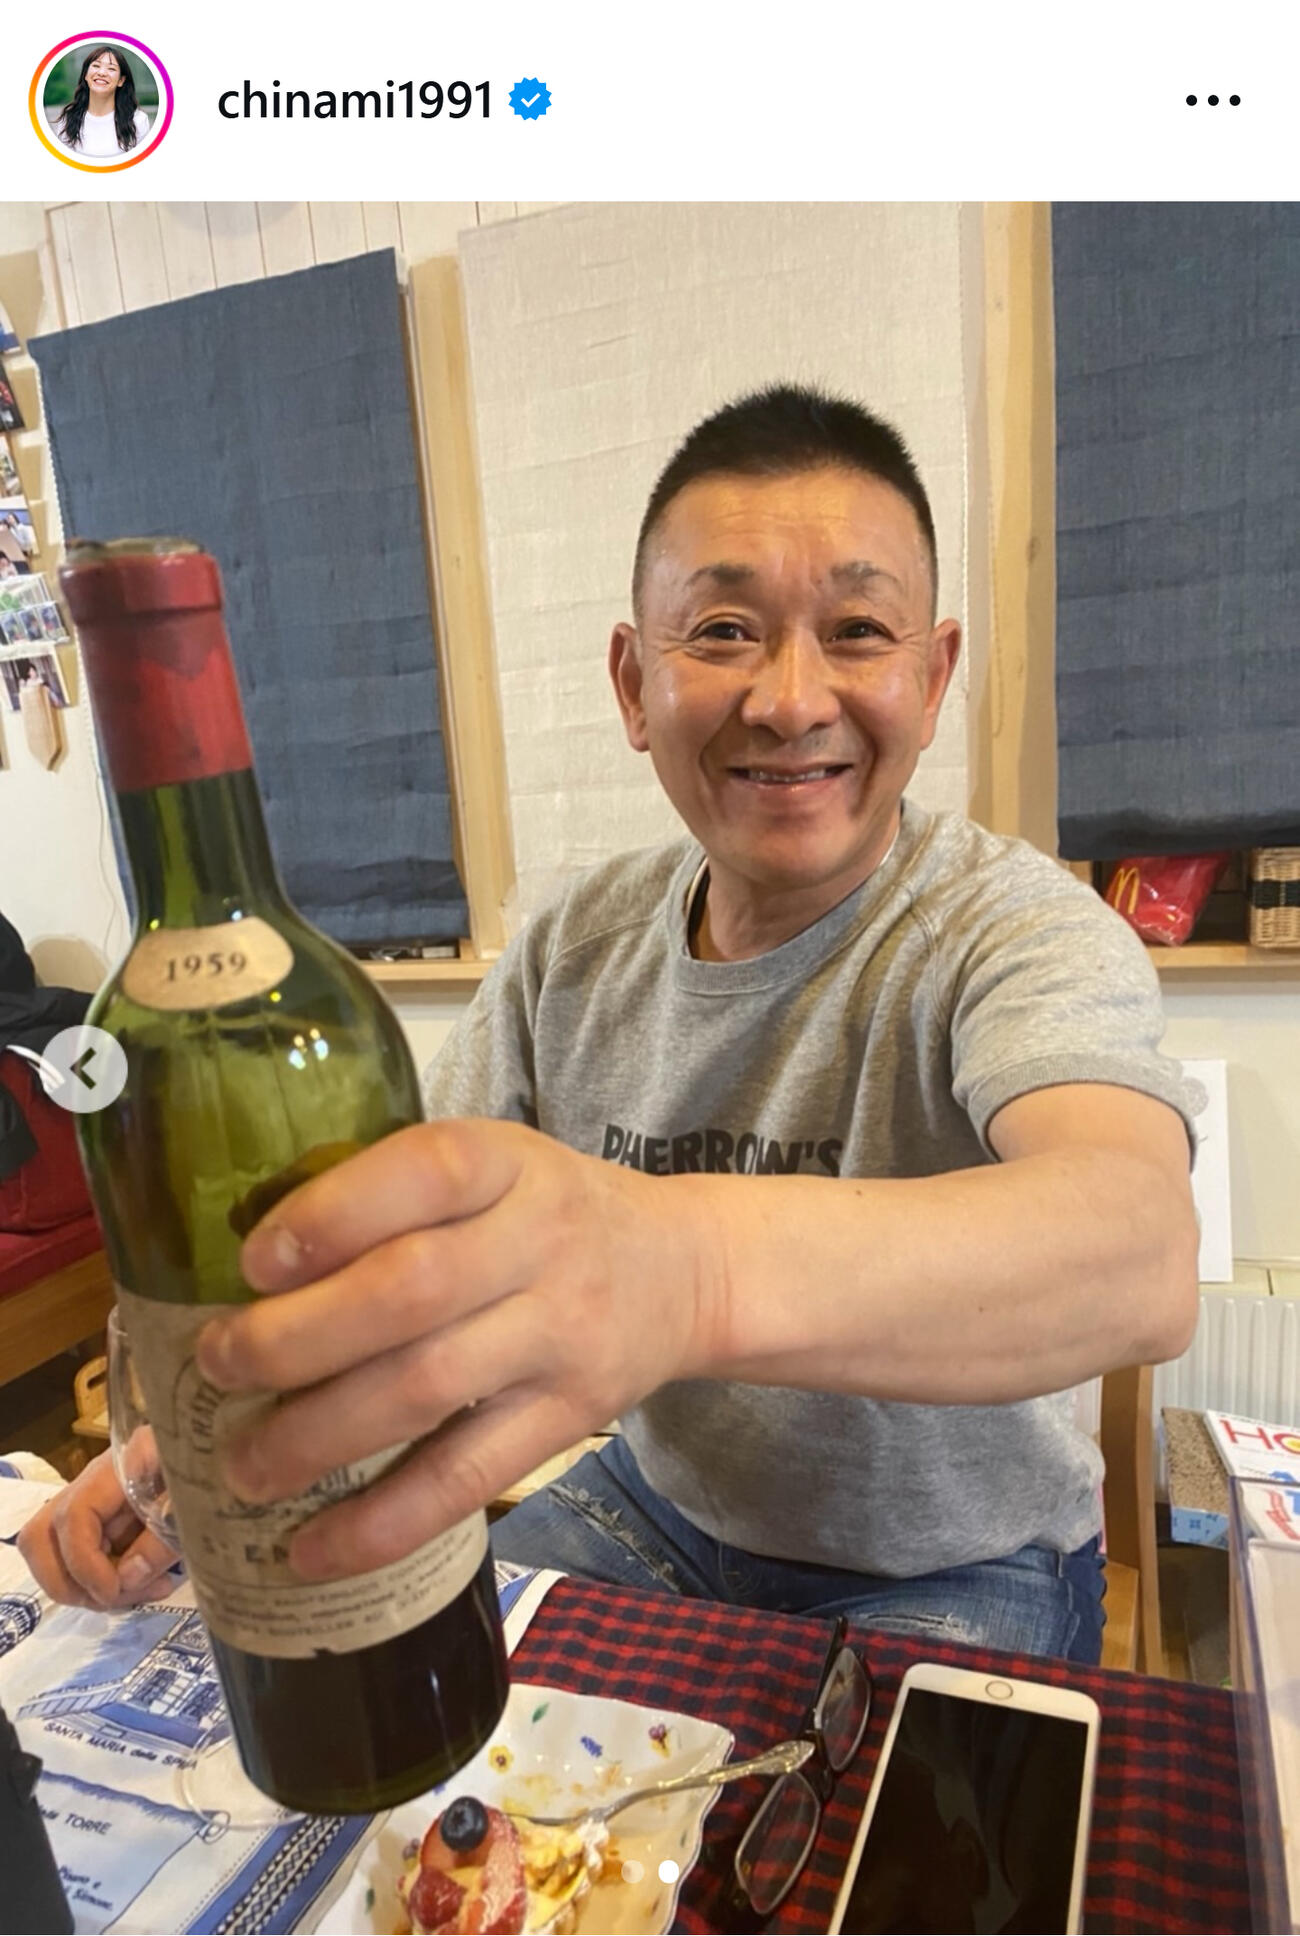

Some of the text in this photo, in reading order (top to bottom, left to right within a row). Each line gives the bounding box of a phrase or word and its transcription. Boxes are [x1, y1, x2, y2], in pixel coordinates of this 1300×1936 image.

[167, 951, 247, 982] 1959
[602, 1123, 843, 1176] PHERROW'S
[44, 1722, 83, 1741] SANTA
[87, 1736, 127, 1755] MARIA
[64, 1813, 112, 1835] TORRE
